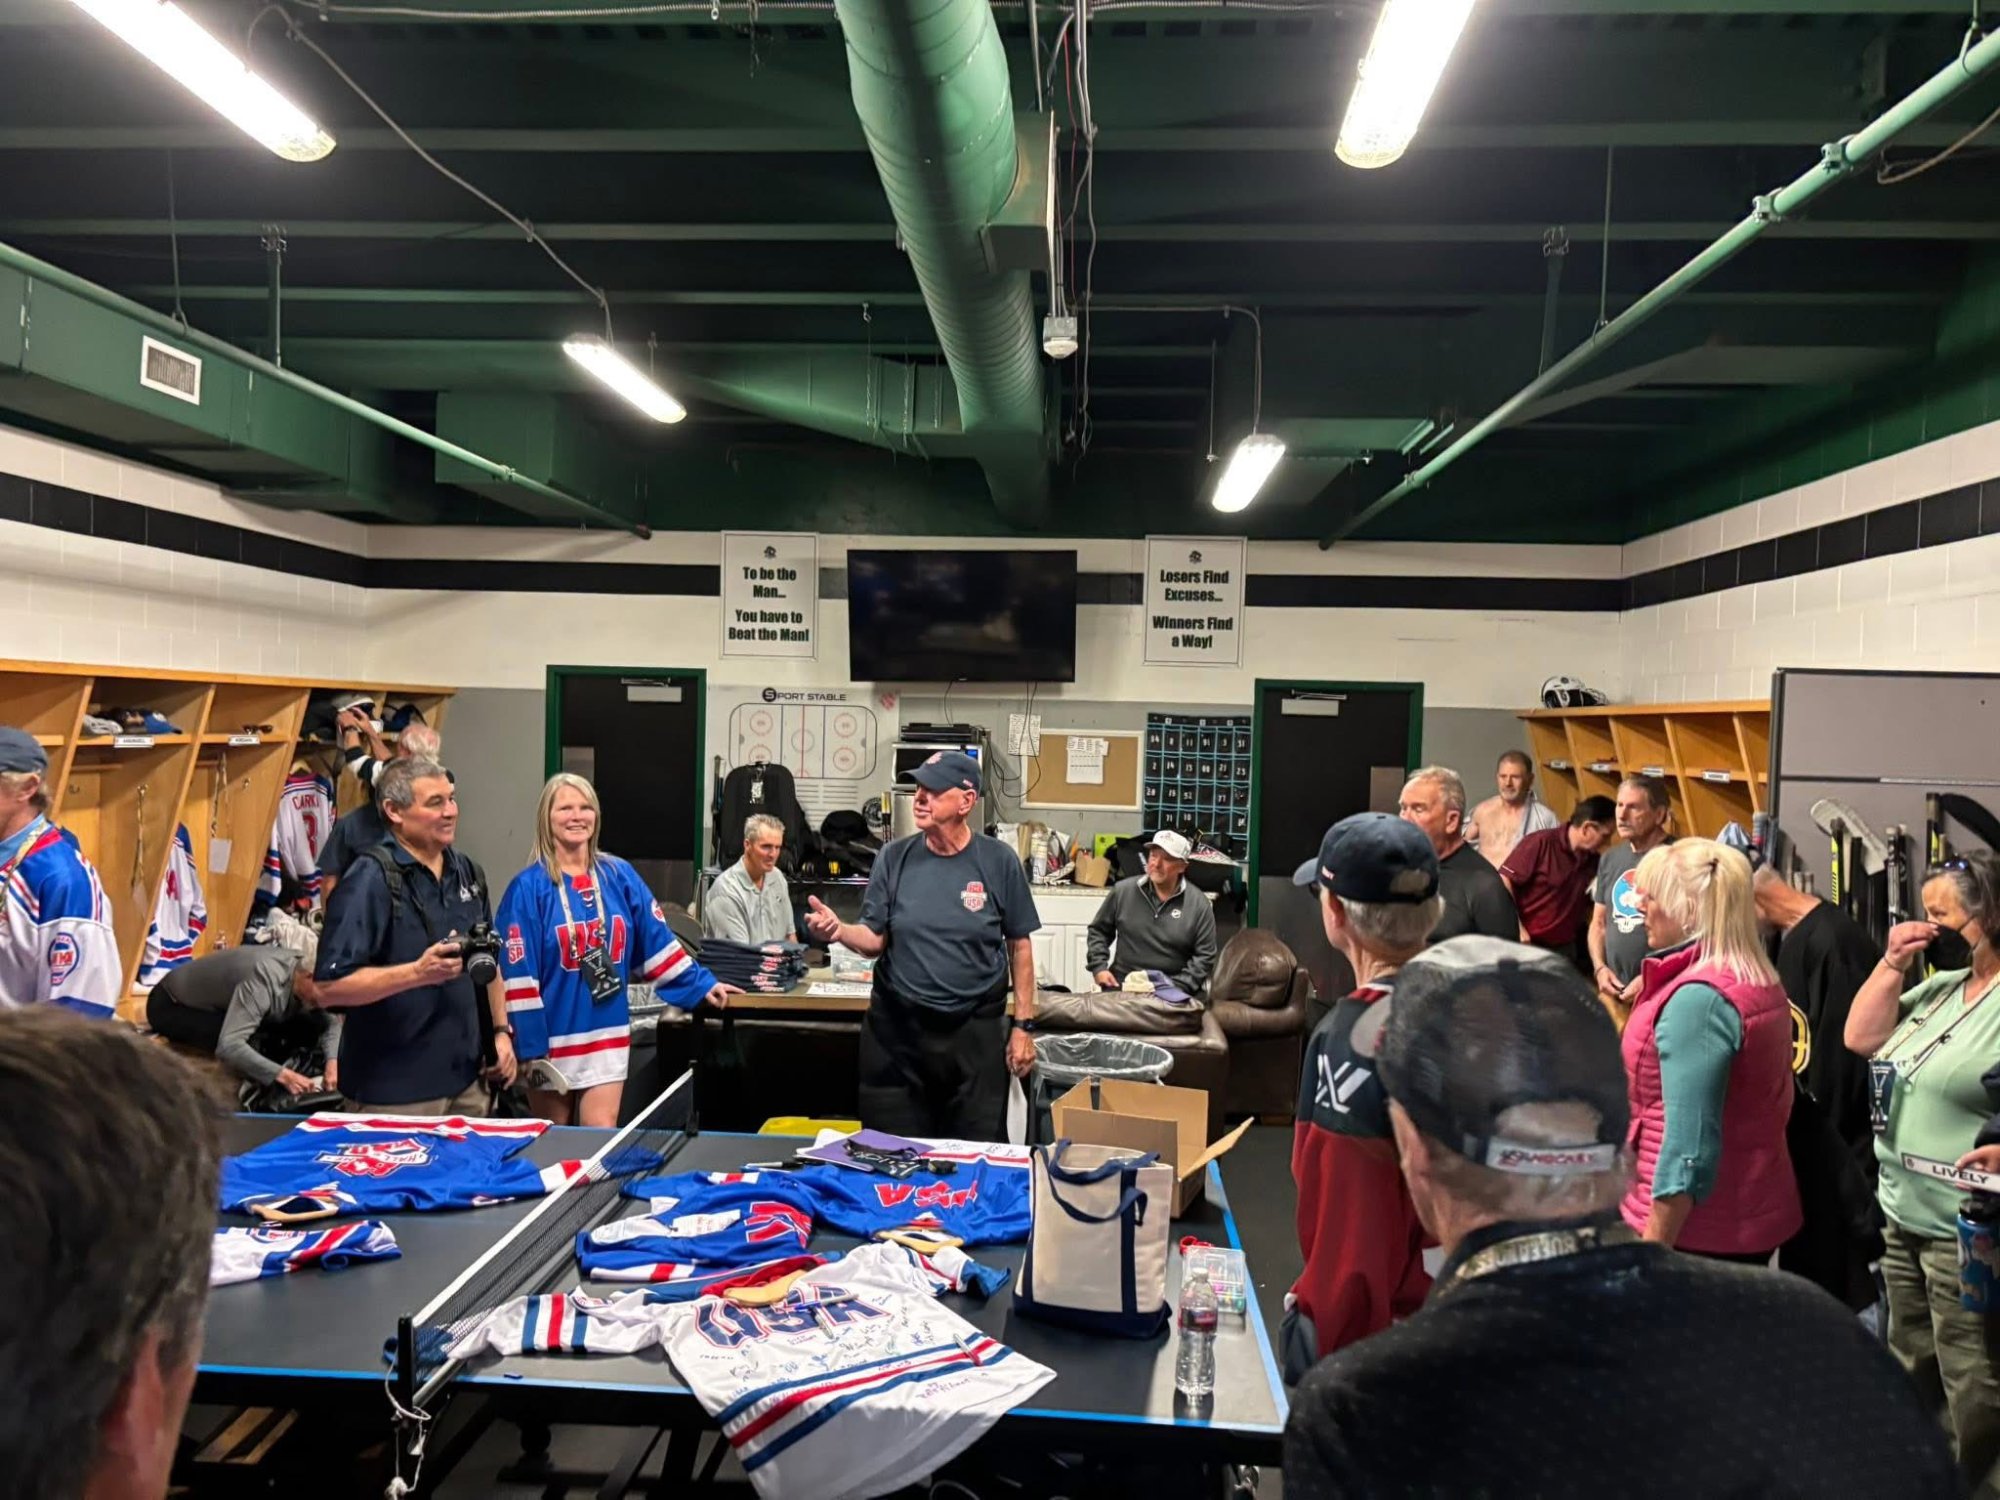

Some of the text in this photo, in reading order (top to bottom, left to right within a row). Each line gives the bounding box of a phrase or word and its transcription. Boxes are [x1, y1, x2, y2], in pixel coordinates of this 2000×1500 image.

[743, 566, 797, 581] To be the
[1160, 569, 1229, 584] Losers Find
[753, 585, 786, 598] Man...
[1165, 588, 1223, 602] Excuses...
[735, 609, 803, 624] You have to
[1152, 616, 1233, 630] Winners Find
[728, 627, 809, 642] Beat the Man!
[1171, 634, 1213, 649] a Way!
[762, 687, 846, 702] SPORT STABLE
[1932, 1165, 1989, 1184] LIVELY
[694, 1283, 892, 1350] USA
